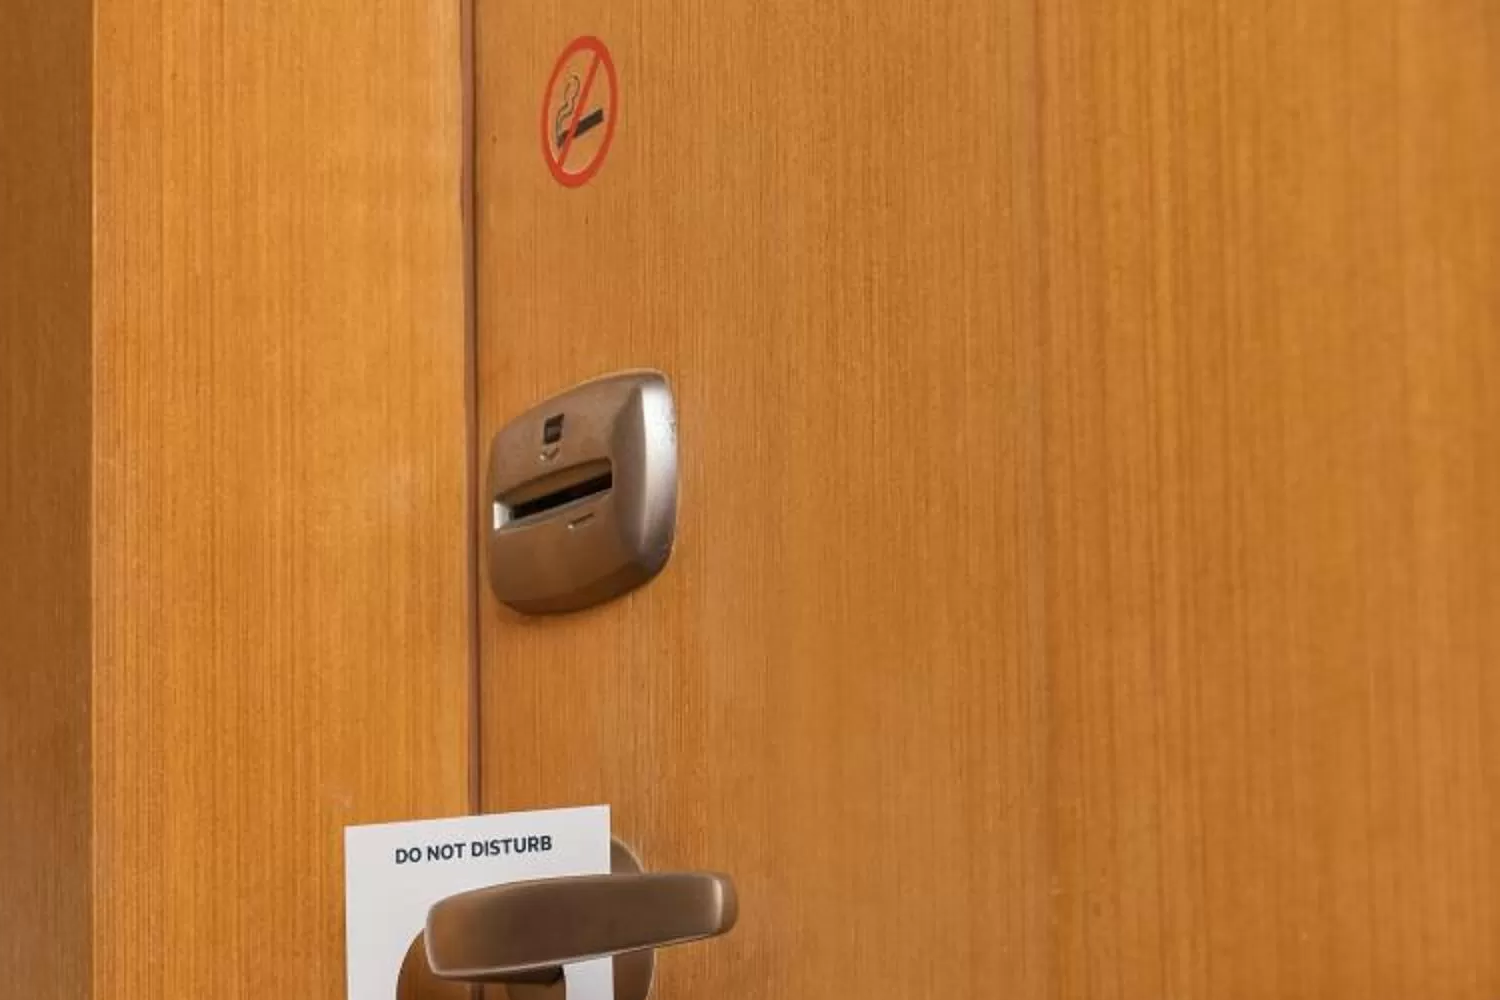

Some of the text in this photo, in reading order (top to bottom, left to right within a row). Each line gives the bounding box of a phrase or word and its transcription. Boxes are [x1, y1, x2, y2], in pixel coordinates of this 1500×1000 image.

[395, 835, 553, 865] DO NOT DISTURB
